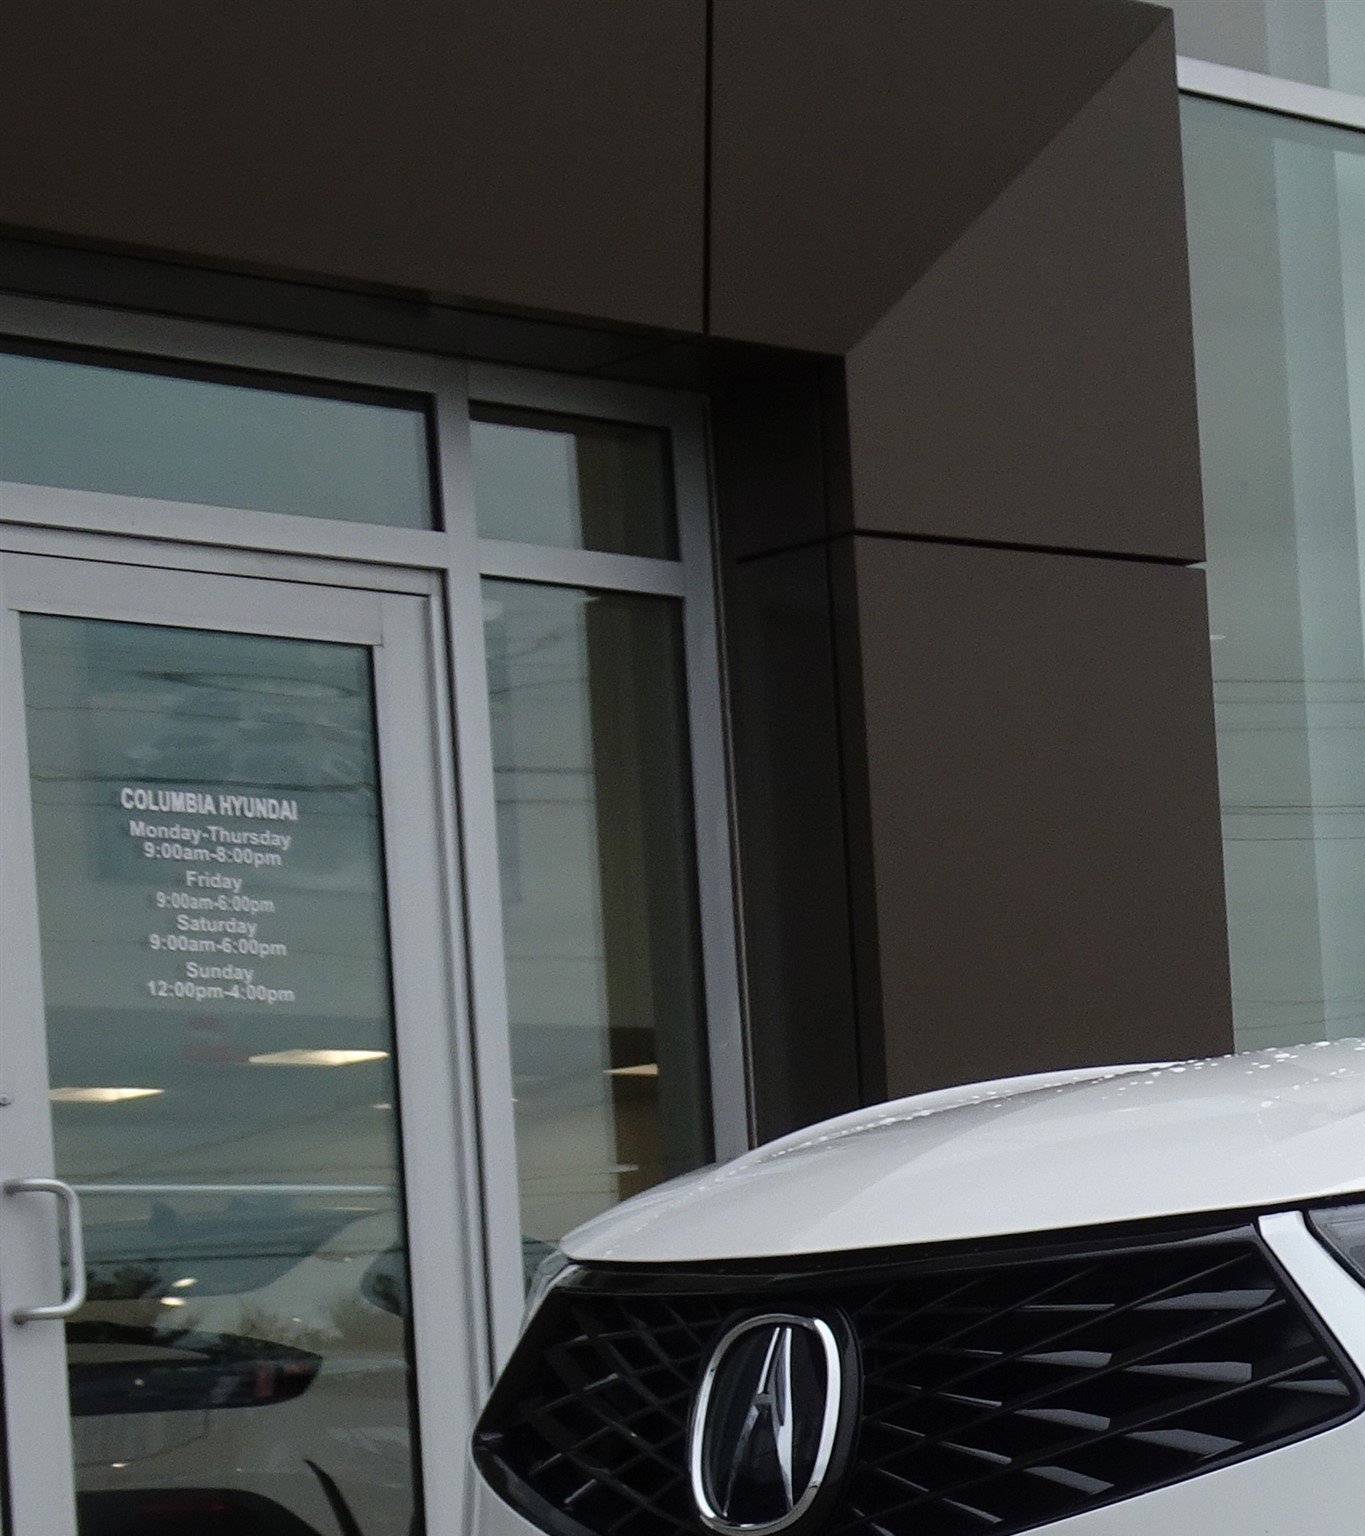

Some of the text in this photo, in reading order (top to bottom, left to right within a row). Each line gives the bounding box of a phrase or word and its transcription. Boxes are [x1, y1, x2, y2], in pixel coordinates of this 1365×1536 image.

[120, 787, 298, 821] COLUMBIA HYUNDAI
[129, 820, 291, 851] Monday-Thursday
[144, 841, 282, 868] 9:00am-8:00pm
[186, 870, 243, 893] Friday
[176, 914, 258, 937] Saturday
[150, 933, 287, 957] 9:00am-6:00pm
[185, 961, 255, 983] Sunday
[149, 980, 295, 1005] 12:00pm-4:00pm
